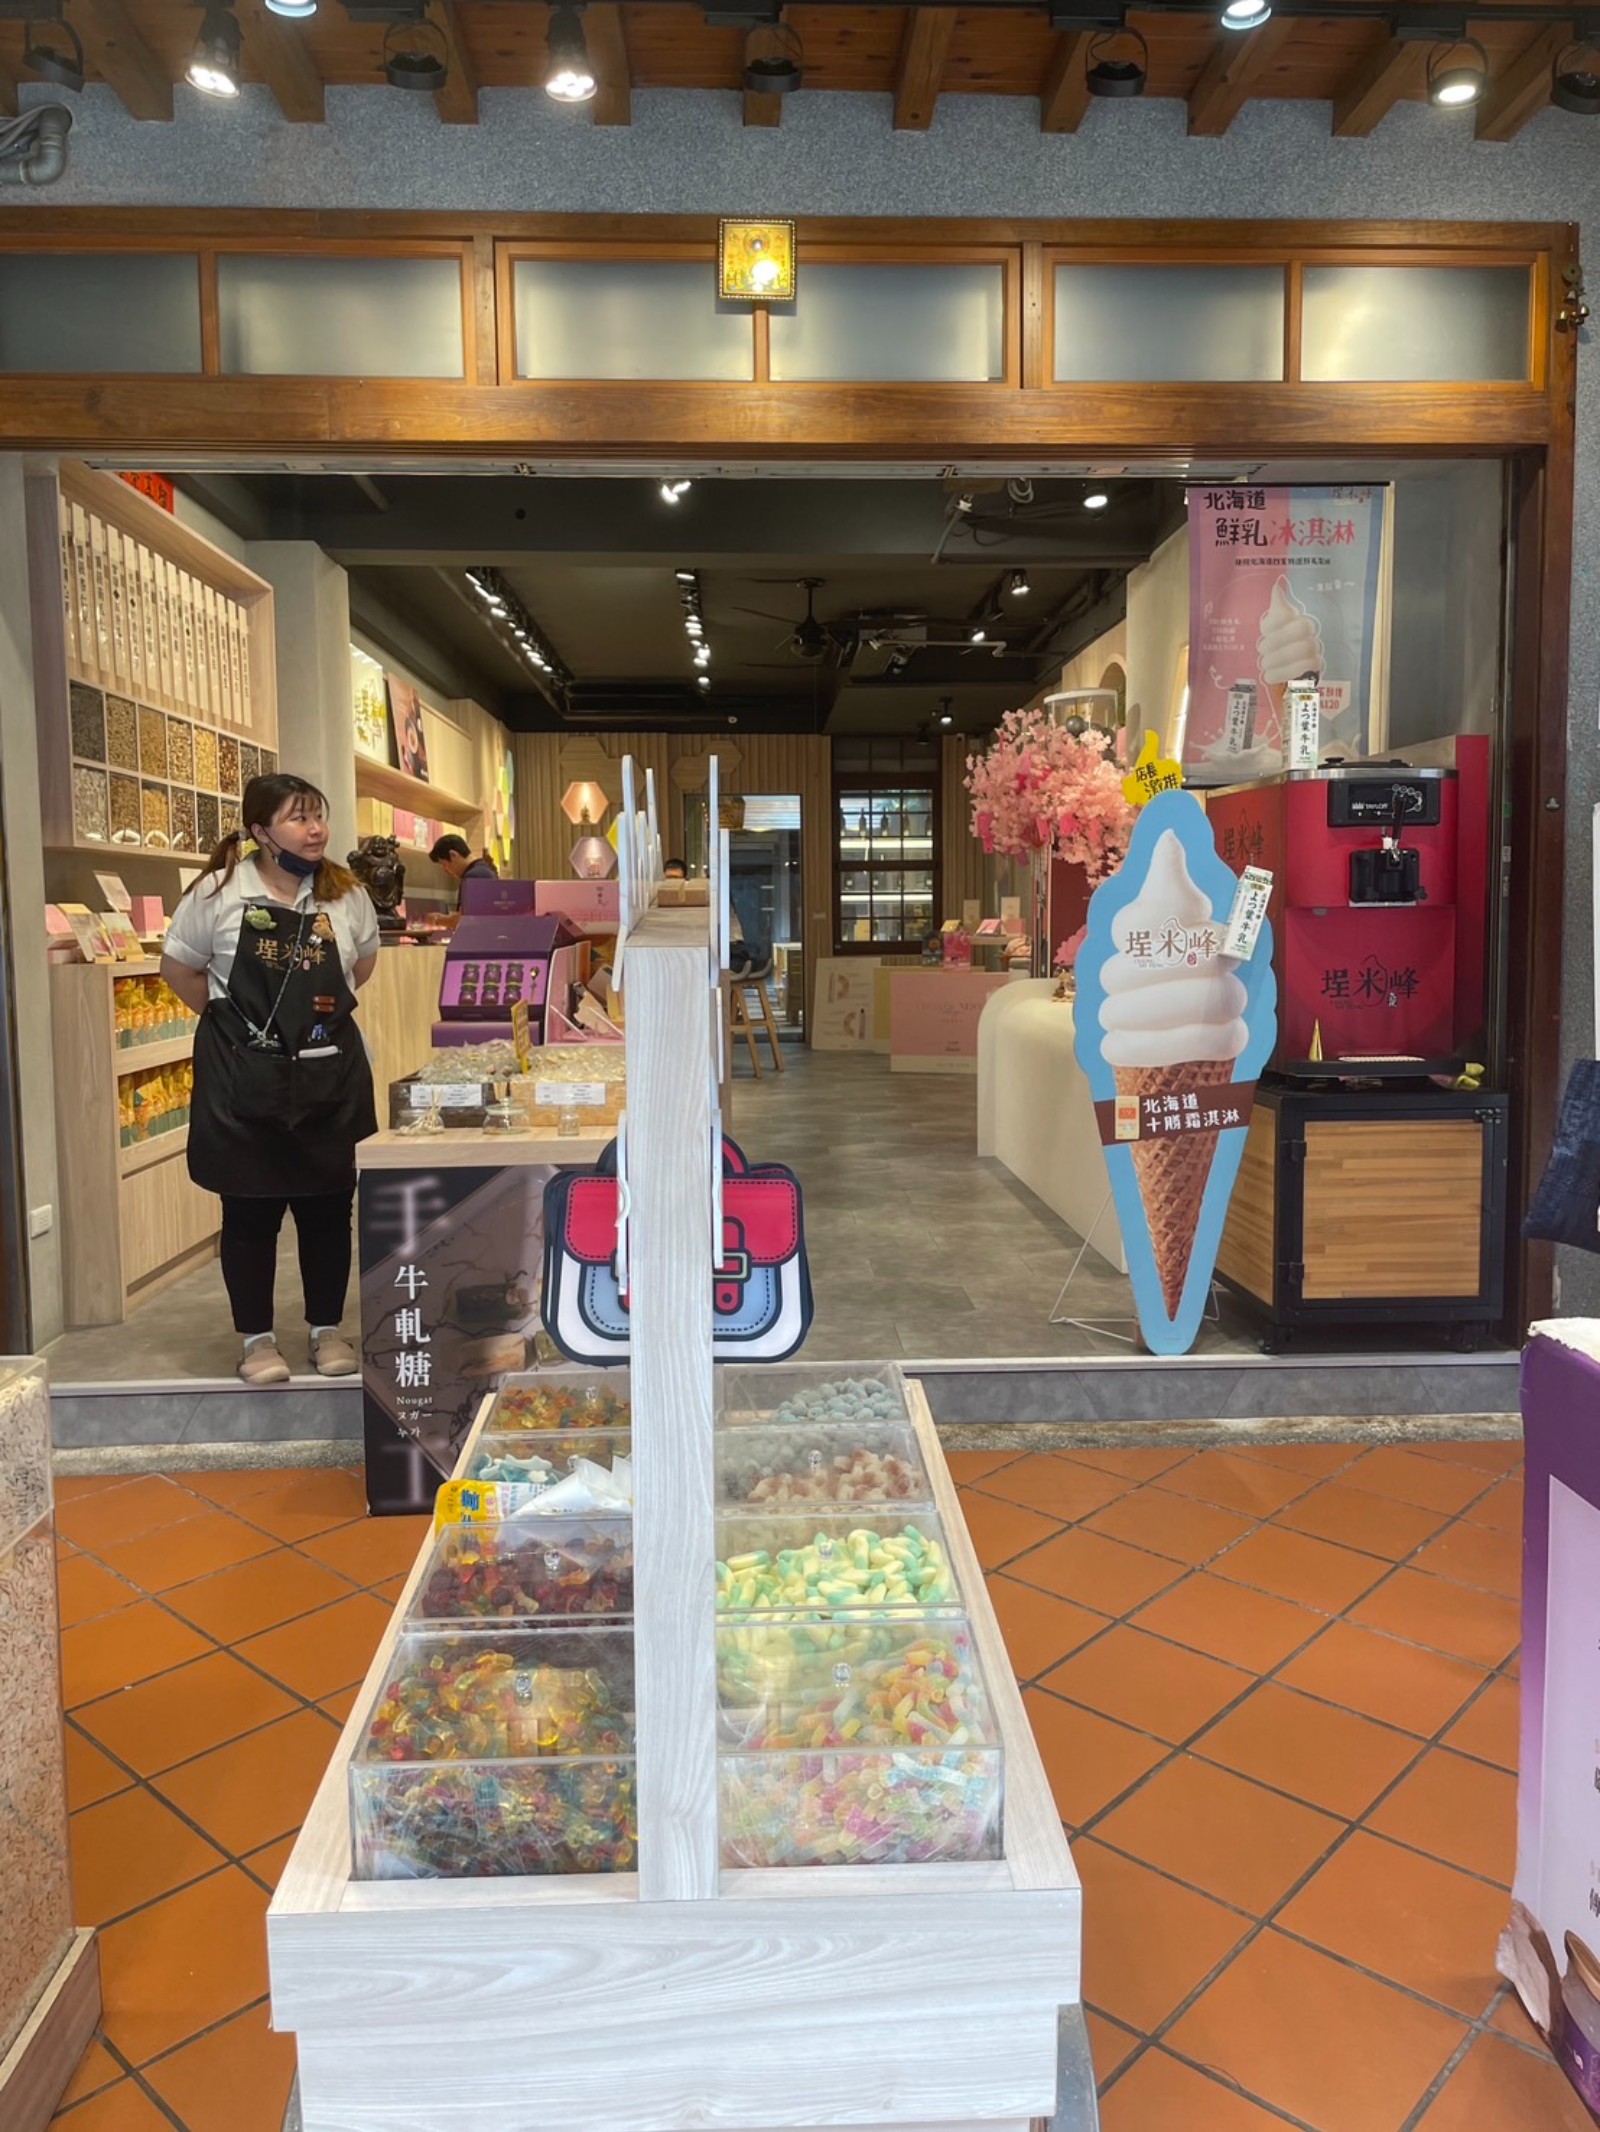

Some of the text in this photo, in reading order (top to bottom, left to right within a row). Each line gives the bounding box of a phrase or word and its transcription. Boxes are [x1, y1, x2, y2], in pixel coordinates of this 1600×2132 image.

[1204, 489, 1267, 511] 北海道
[1135, 762, 1157, 782] 店長
[1124, 928, 1218, 958] 埕米峰
[1321, 967, 1420, 999] 埕米峰
[1142, 1093, 1200, 1114] 北海道
[393, 1264, 433, 1388] 牛軋糖
[396, 1396, 433, 1407] Nougat
[397, 1410, 433, 1421] ヌガー
[397, 1426, 421, 1439] 누가
